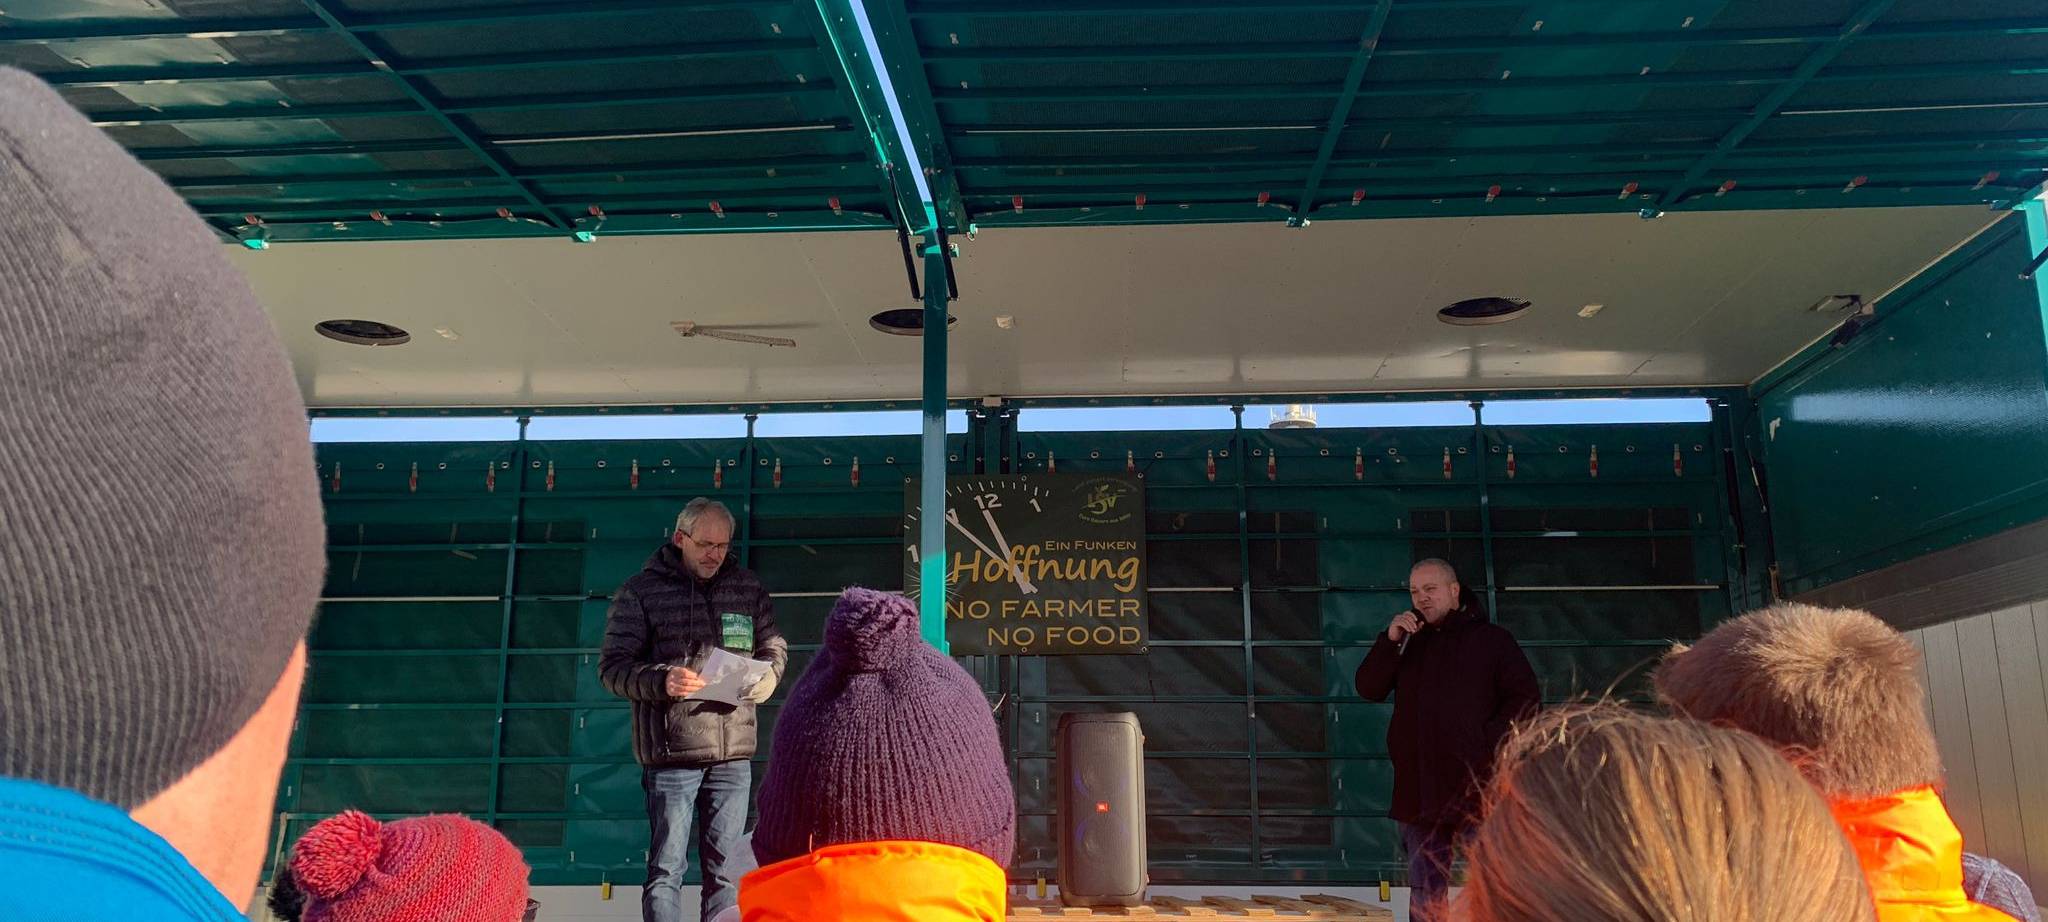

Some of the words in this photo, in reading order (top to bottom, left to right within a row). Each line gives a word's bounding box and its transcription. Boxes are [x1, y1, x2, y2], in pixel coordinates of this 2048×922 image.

[974, 494, 1002, 510] 12
[1029, 498, 1041, 513] 1
[952, 545, 1140, 592] Hoffnung
[945, 600, 991, 619] NO
[1002, 599, 1140, 618] FARMER
[988, 626, 1035, 646] NO
[1047, 626, 1141, 646] FOOD
